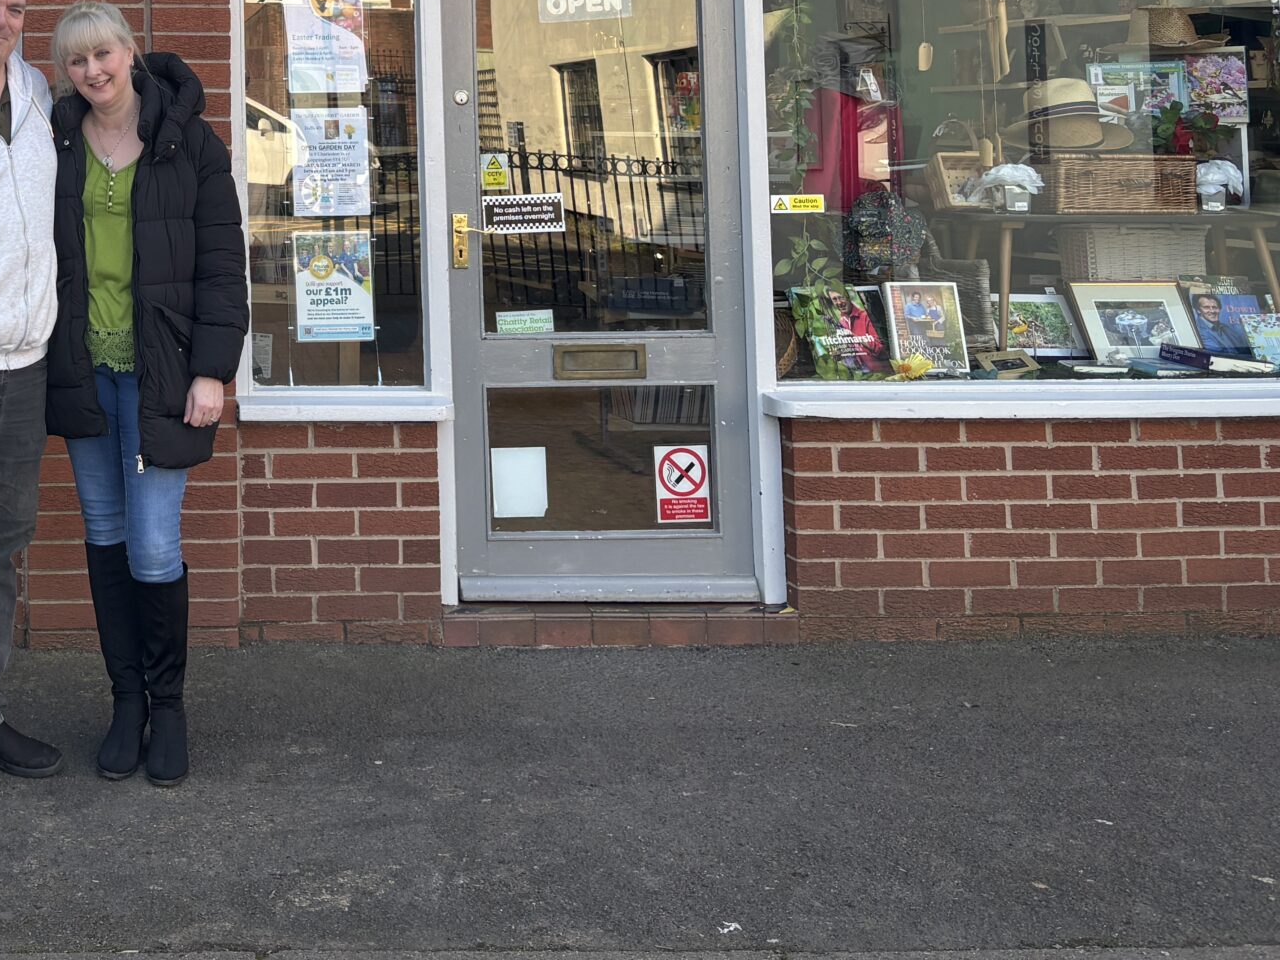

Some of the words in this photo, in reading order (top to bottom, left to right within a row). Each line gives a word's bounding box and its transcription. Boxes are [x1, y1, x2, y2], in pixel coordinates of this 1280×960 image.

[315, 34, 340, 42] Trading
[493, 214, 523, 222] premises
[524, 212, 555, 220] overnight
[324, 287, 352, 296] £1m
[309, 296, 348, 307] appeal?
[497, 318, 528, 326] Charity
[529, 316, 553, 324] Retail
[499, 325, 544, 333] Association
[821, 333, 874, 345] Titchmarsh
[900, 340, 926, 348] HOME
[901, 346, 951, 355] COOKBOOK
